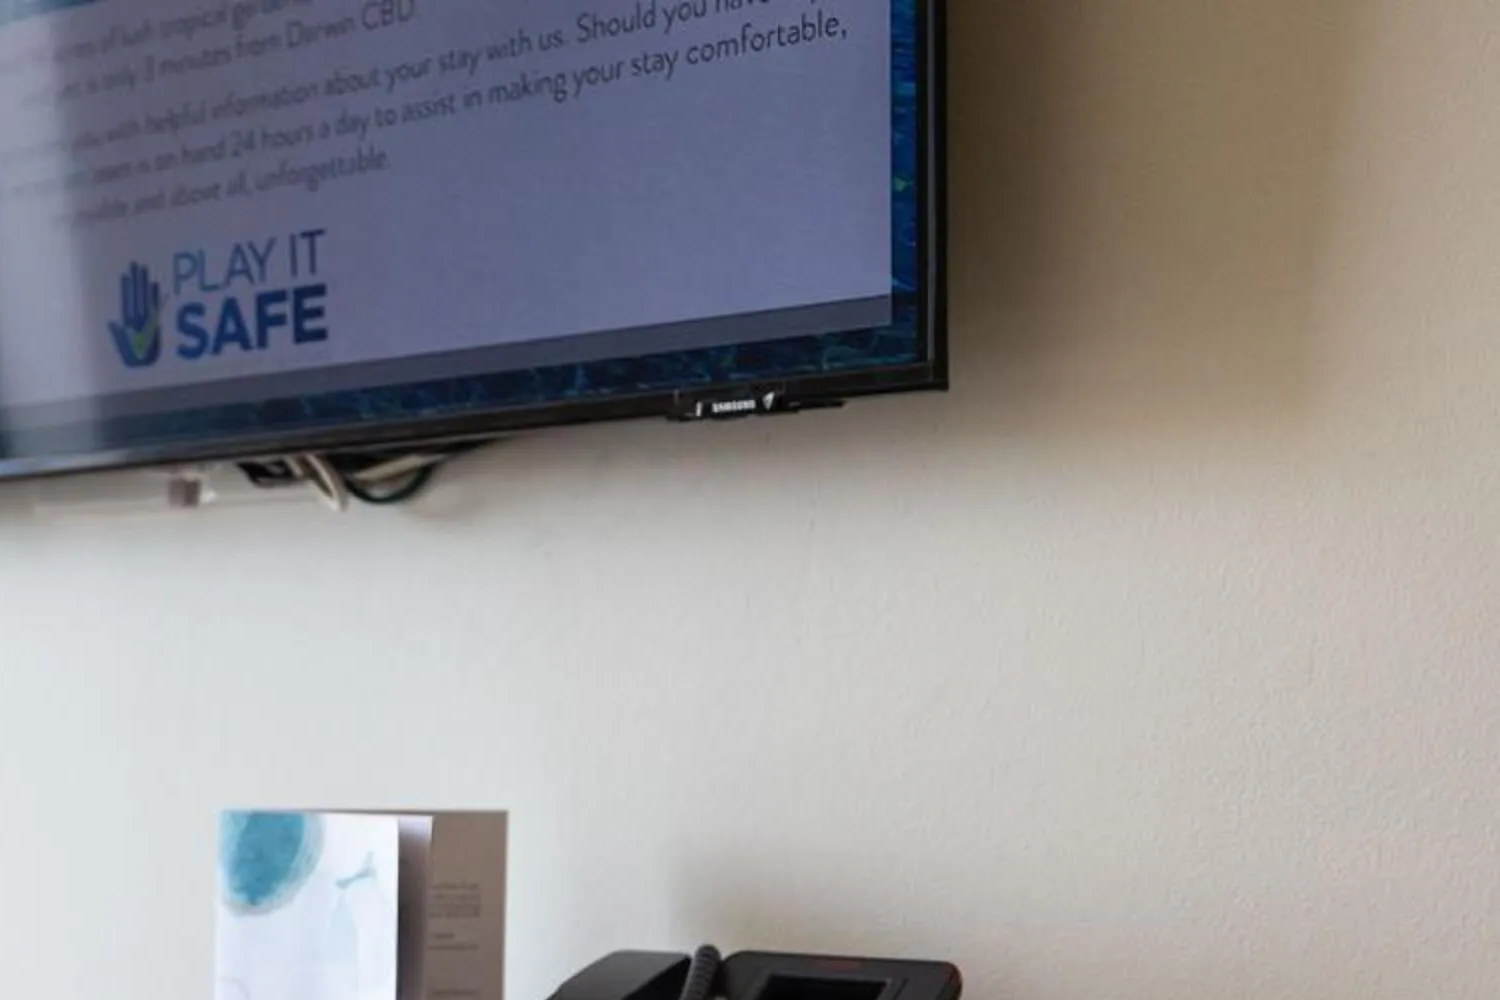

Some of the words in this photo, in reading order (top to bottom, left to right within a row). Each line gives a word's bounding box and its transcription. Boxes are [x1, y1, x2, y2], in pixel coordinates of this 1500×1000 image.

[285, 17, 356, 49] Darwin
[324, 65, 381, 96] about
[384, 56, 433, 95] your
[437, 48, 481, 78] stay
[486, 27, 533, 61] with
[576, 0, 656, 44] Should
[663, 0, 707, 35] you
[231, 128, 256, 158] 24
[261, 121, 315, 149] hours
[318, 121, 331, 140] a
[334, 107, 372, 142] day
[374, 106, 399, 129] to
[402, 88, 457, 124] assist
[463, 85, 484, 110] in
[488, 70, 569, 104] making
[571, 59, 624, 98] your
[631, 49, 678, 80] stay
[686, 10, 848, 65] comfortable,
[173, 236, 279, 297] PLAY
[289, 227, 327, 280] IT
[175, 282, 329, 360] SAFE
